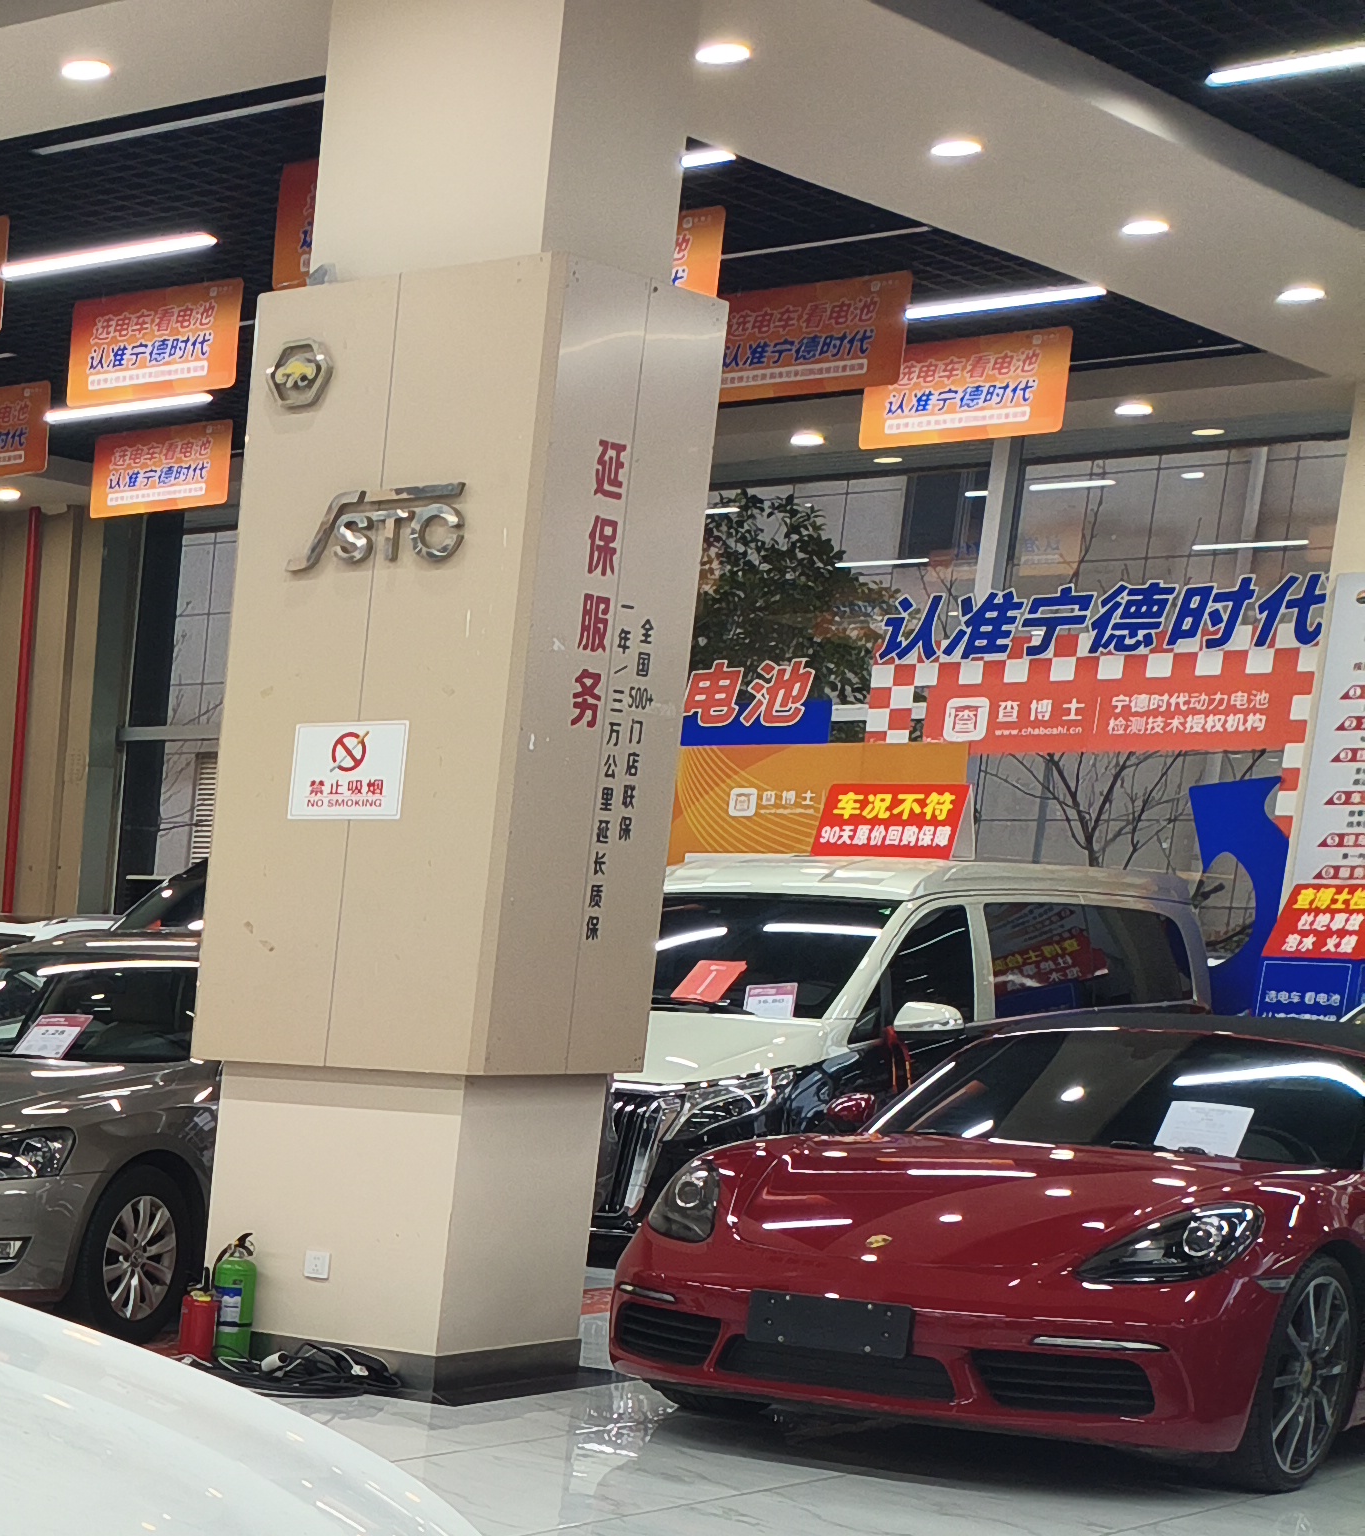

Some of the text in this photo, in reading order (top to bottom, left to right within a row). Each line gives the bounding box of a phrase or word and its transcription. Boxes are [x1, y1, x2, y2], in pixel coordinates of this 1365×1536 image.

[570, 438, 627, 729] 延保服务
[876, 572, 1328, 663] 认准宁德时代
[683, 658, 815, 726] 电池
[1111, 689, 1269, 714] 宁德时代动力电池
[997, 699, 1085, 722] 查博士
[1108, 713, 1266, 735] 检测技术授权机构
[309, 779, 384, 796] 禁止吸烟
[307, 798, 382, 808] NO SMOKING
[833, 792, 956, 820] 车况不符
